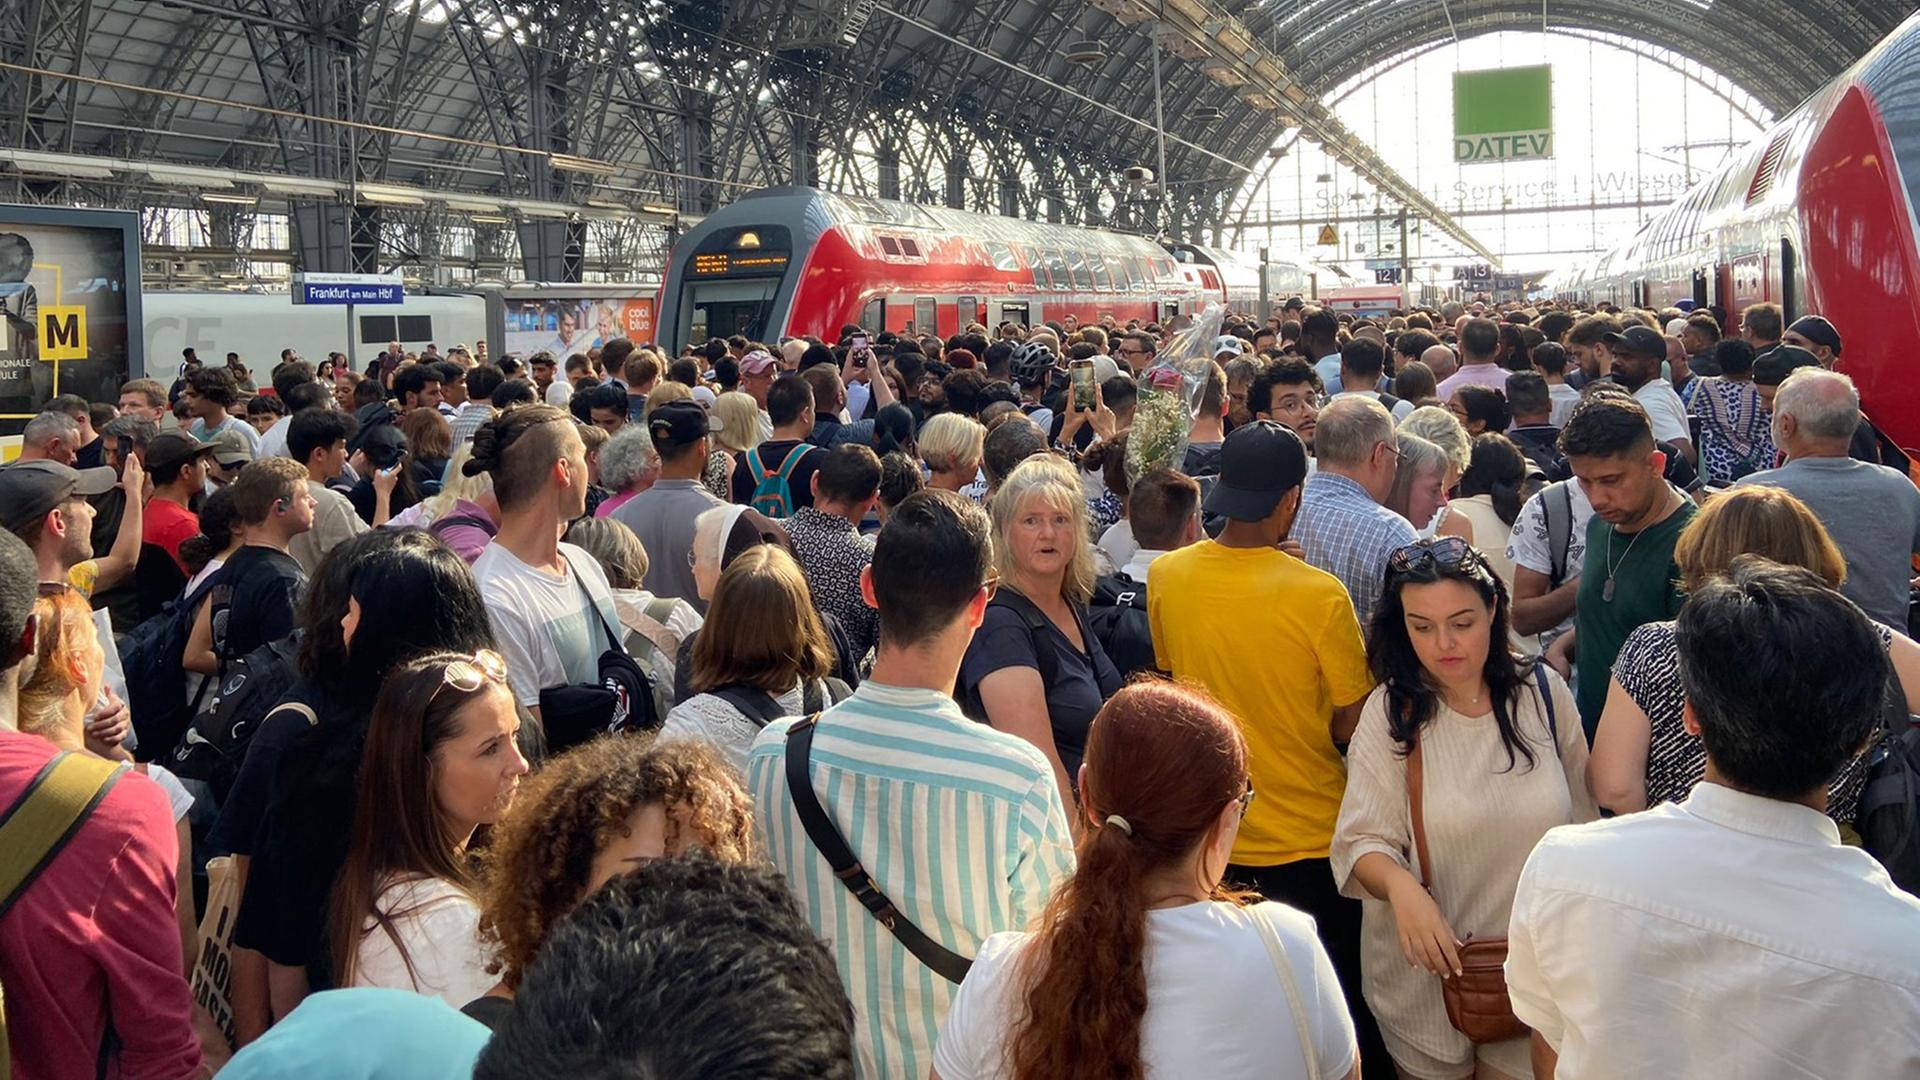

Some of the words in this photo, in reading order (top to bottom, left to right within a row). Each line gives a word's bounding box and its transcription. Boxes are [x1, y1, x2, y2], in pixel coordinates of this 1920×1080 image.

[1456, 134, 1549, 160] DATEV
[1453, 181, 1554, 201] Service
[1376, 270, 1391, 281] 12
[1473, 264, 1487, 277] 13
[310, 287, 349, 299] Frankfurt
[351, 291, 361, 299] am
[362, 291, 377, 299] Main
[378, 288, 392, 299] Hbf
[629, 307, 649, 318] cool
[629, 318, 650, 330] blue
[46, 313, 79, 349] M
[0, 370, 18, 379] ULE
